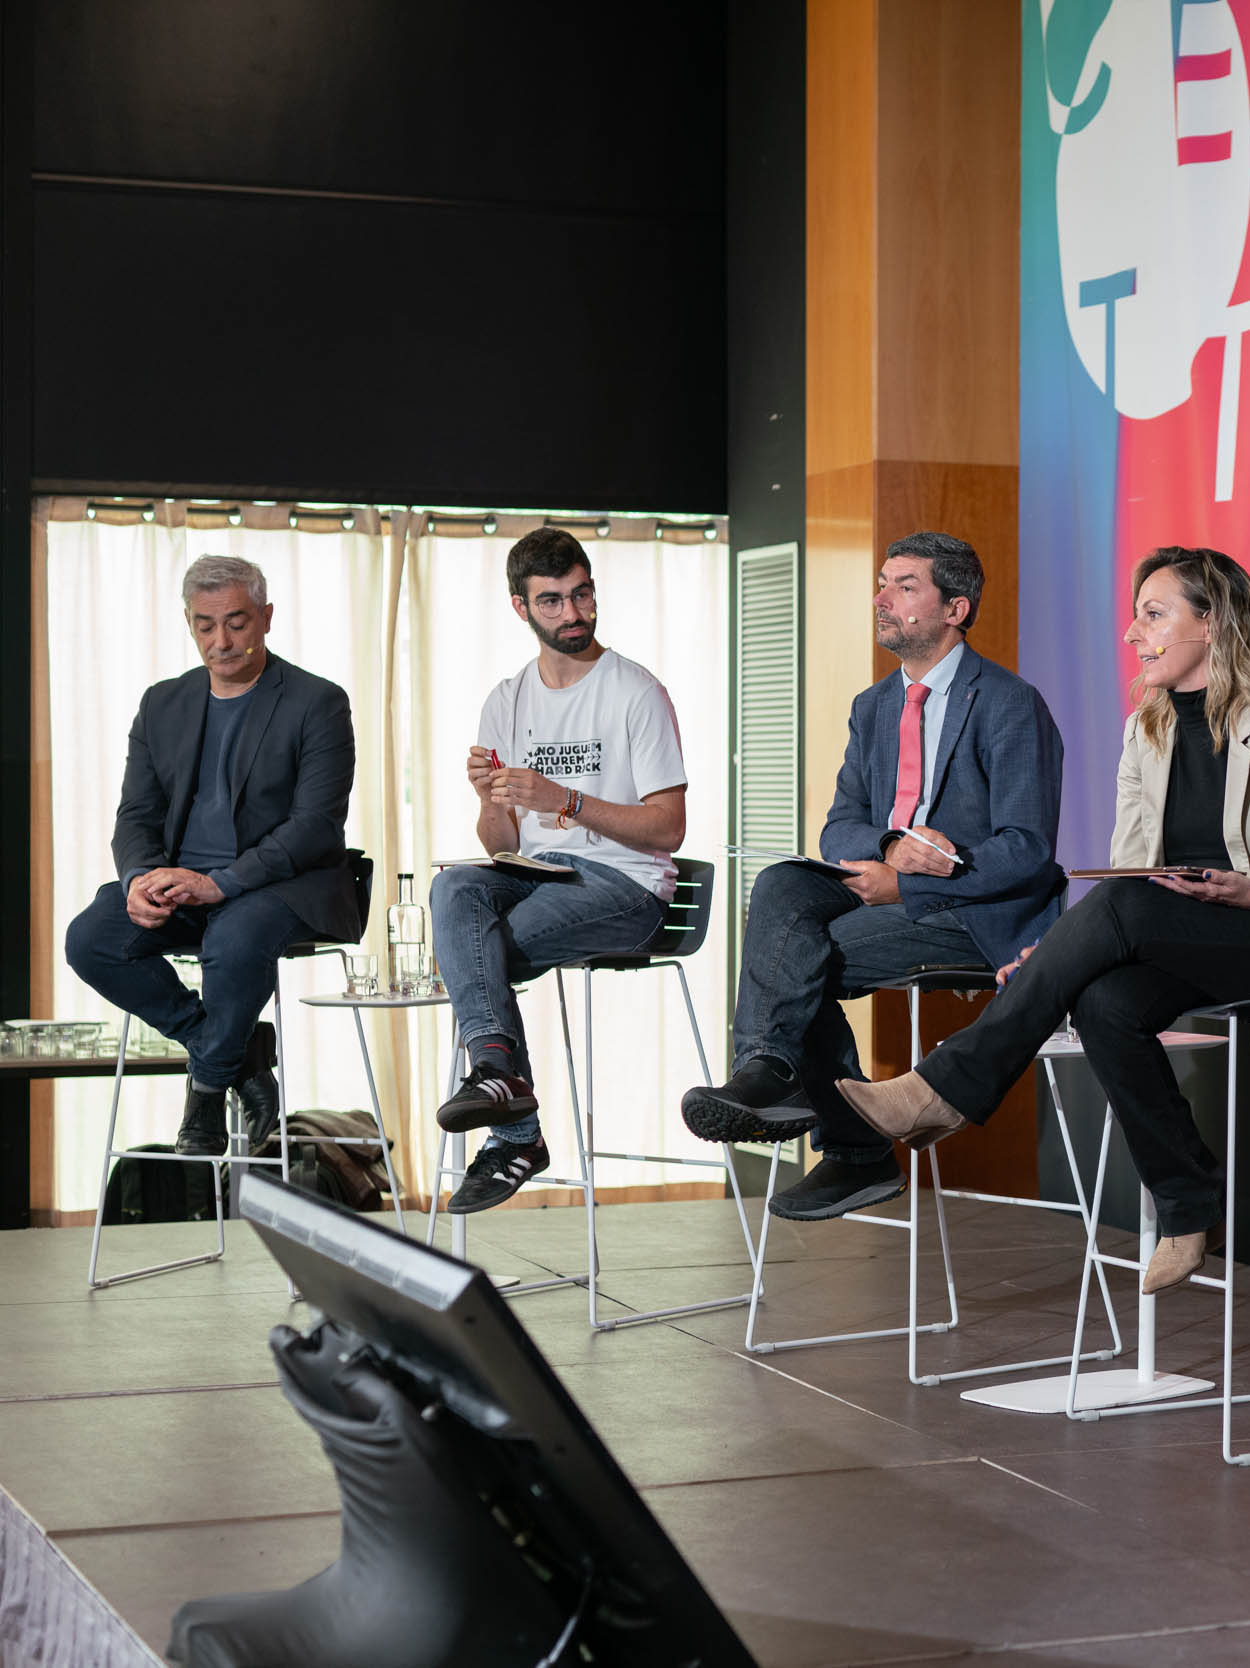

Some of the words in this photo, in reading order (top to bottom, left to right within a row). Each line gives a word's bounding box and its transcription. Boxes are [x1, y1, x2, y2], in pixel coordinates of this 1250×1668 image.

[537, 746, 556, 755] NO
[536, 755, 585, 765] ATUREM
[536, 765, 572, 776] HARD
